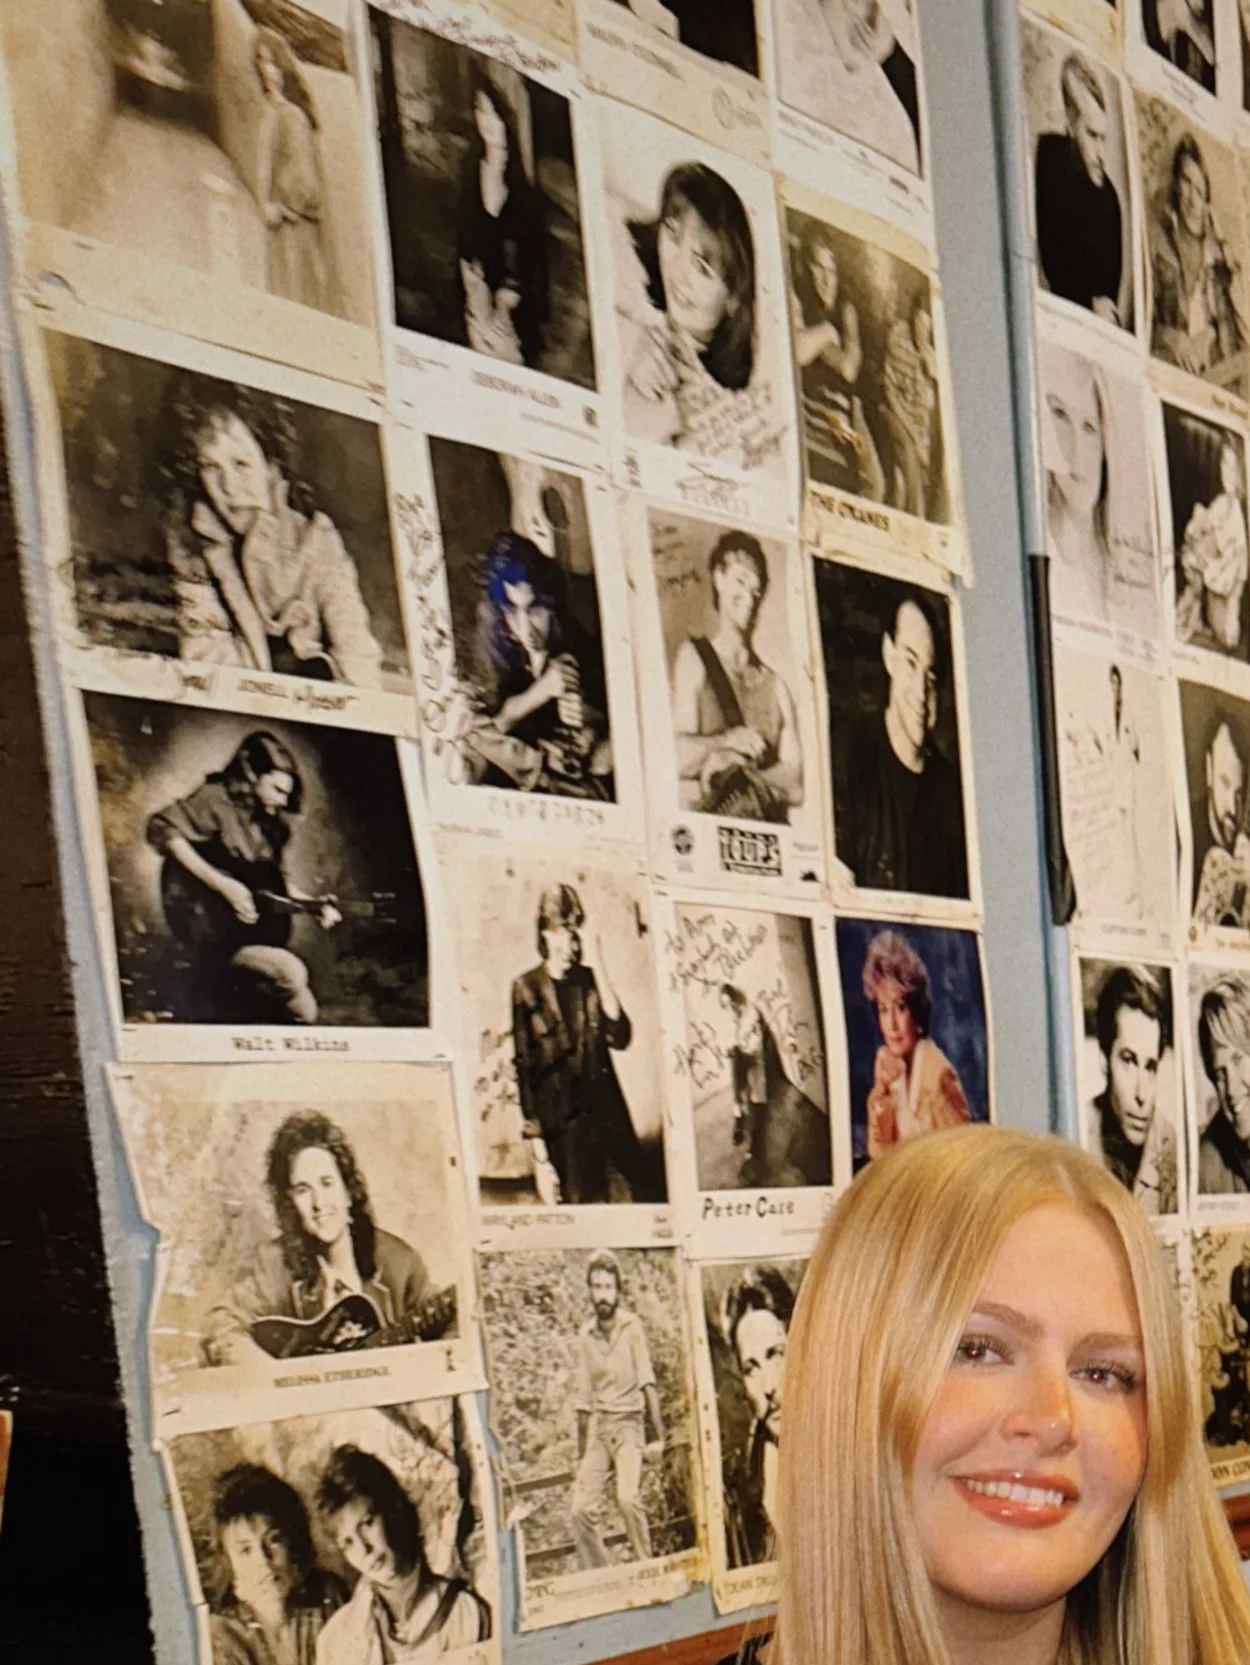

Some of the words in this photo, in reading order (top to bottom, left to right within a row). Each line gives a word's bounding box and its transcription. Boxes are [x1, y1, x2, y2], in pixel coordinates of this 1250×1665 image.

[232, 1036, 275, 1051] Walt
[283, 1036, 350, 1052] Wilkins
[701, 1197, 750, 1220] Peter
[756, 1196, 795, 1218] Case
